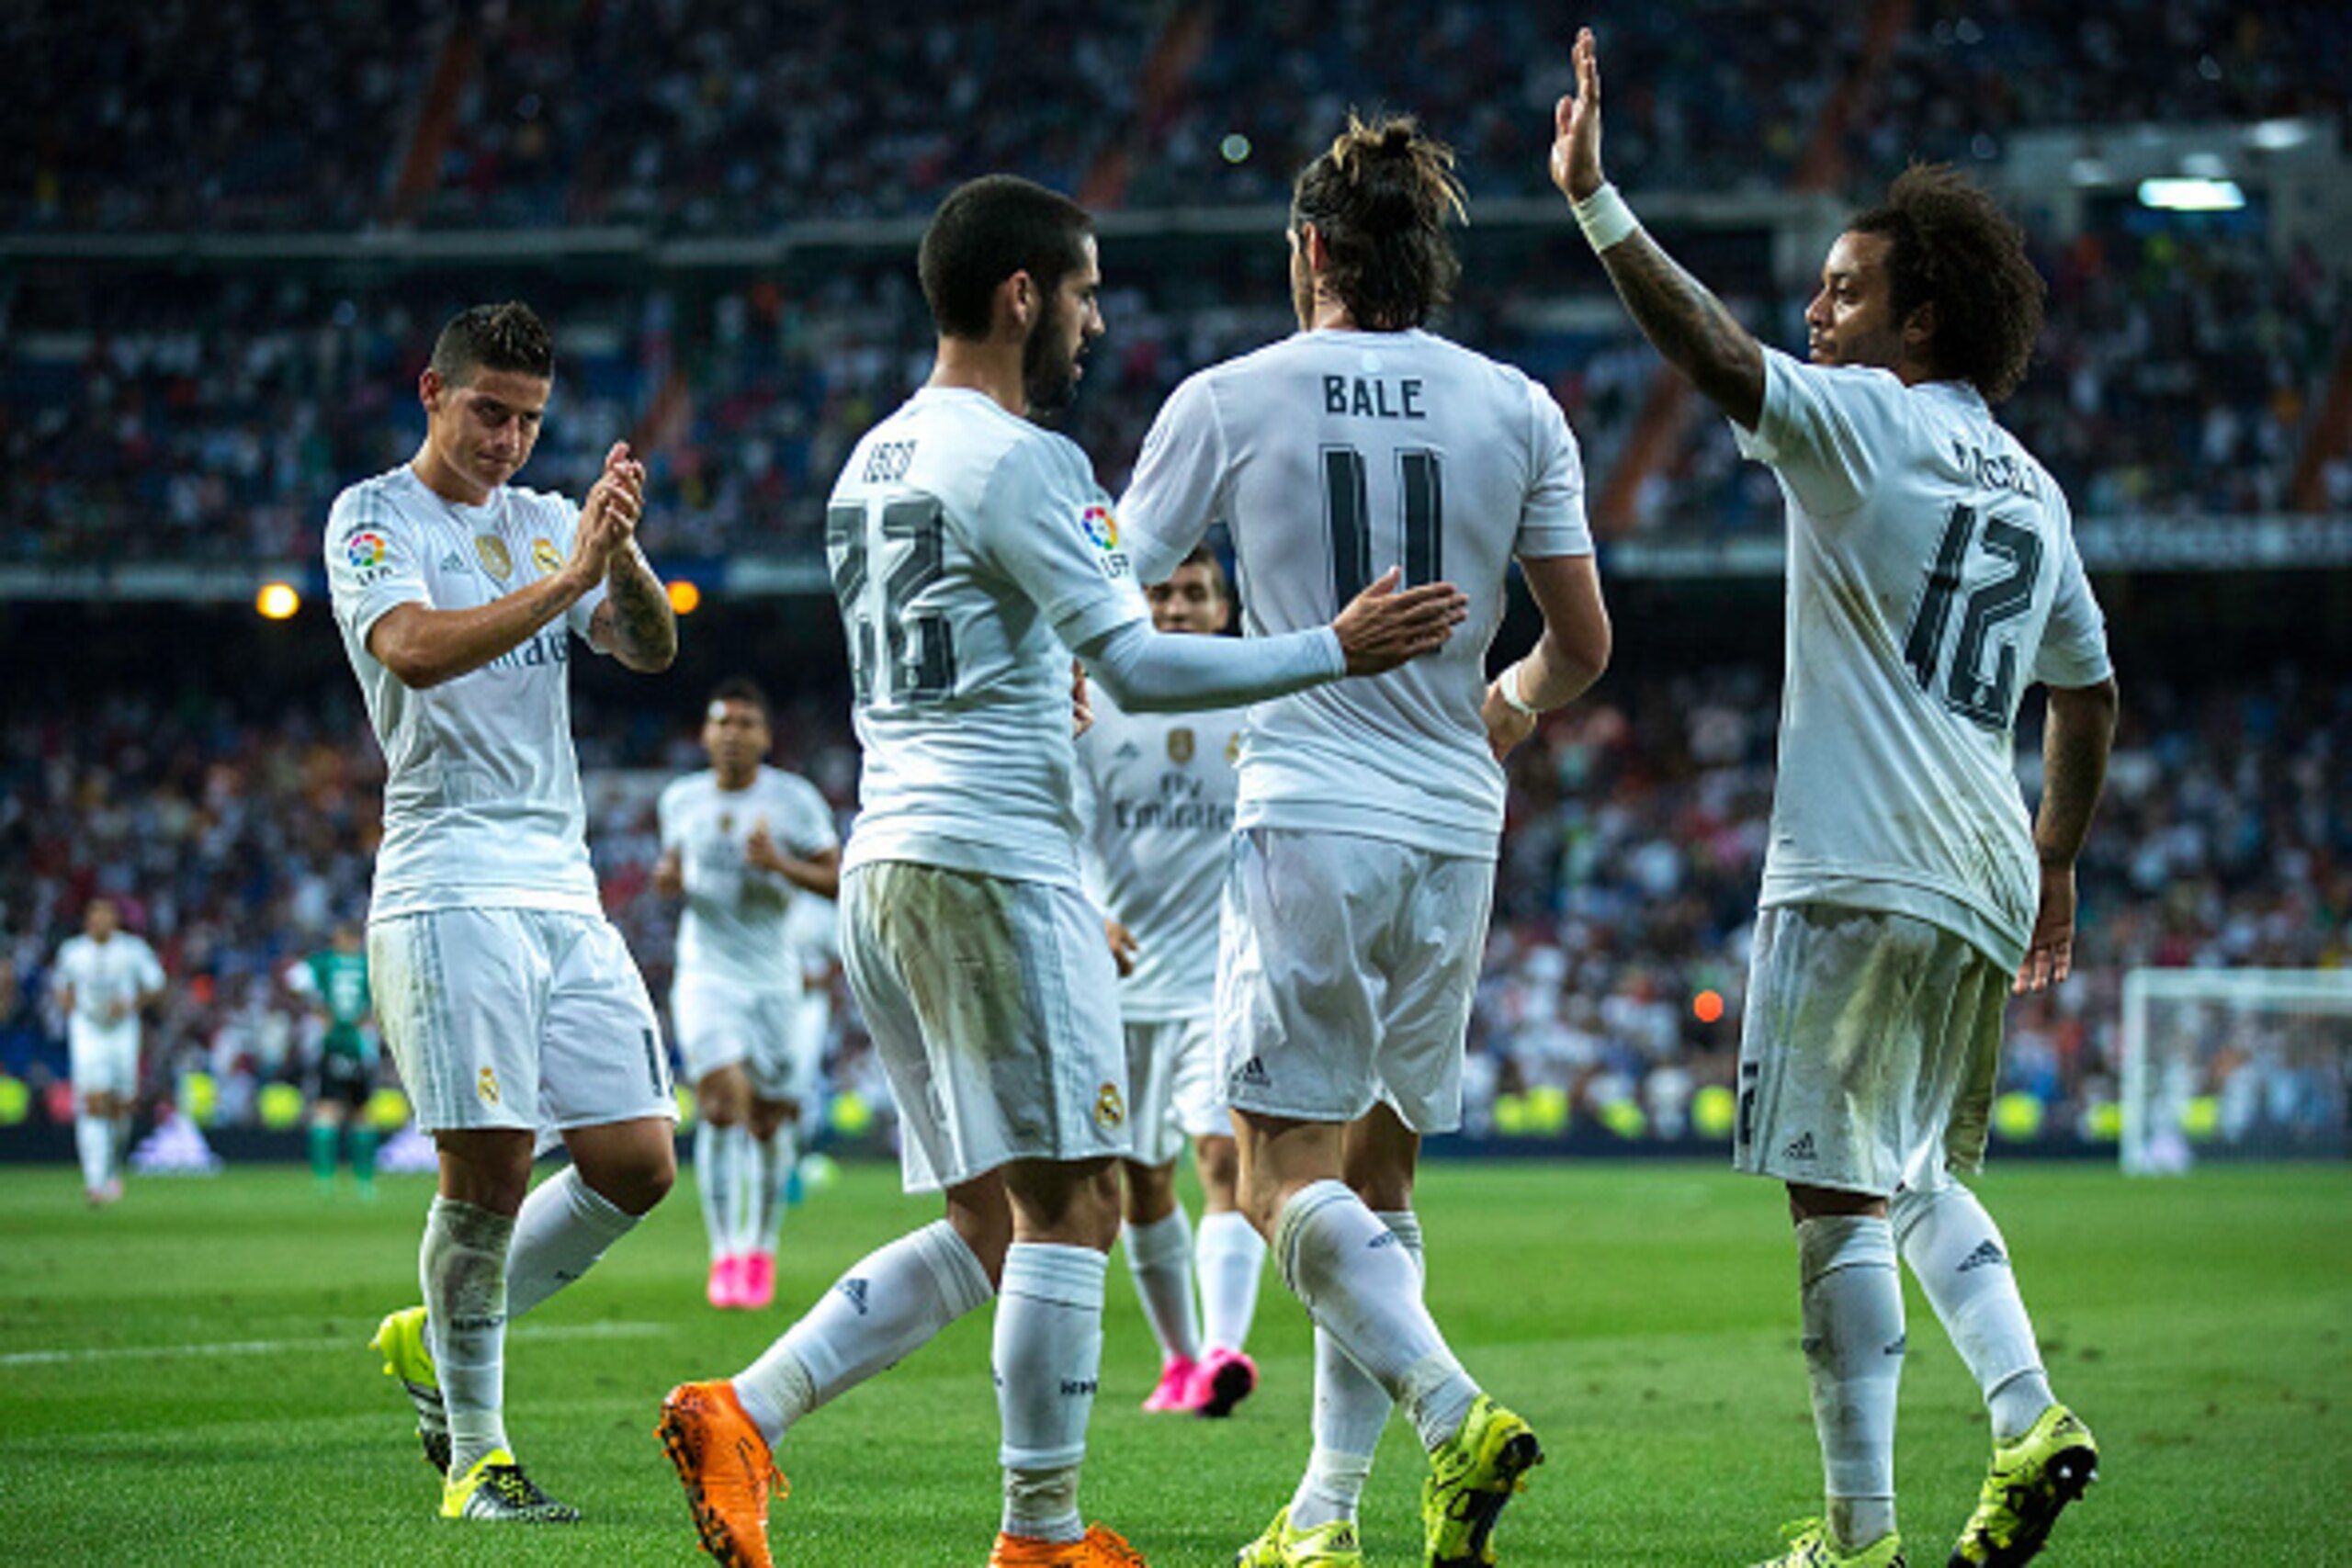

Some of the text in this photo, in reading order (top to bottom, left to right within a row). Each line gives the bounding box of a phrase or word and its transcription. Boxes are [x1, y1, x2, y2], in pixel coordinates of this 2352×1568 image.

[1322, 375, 1427, 419] BALE
[1318, 443, 1444, 647] 11
[1904, 499, 2045, 729] 12
